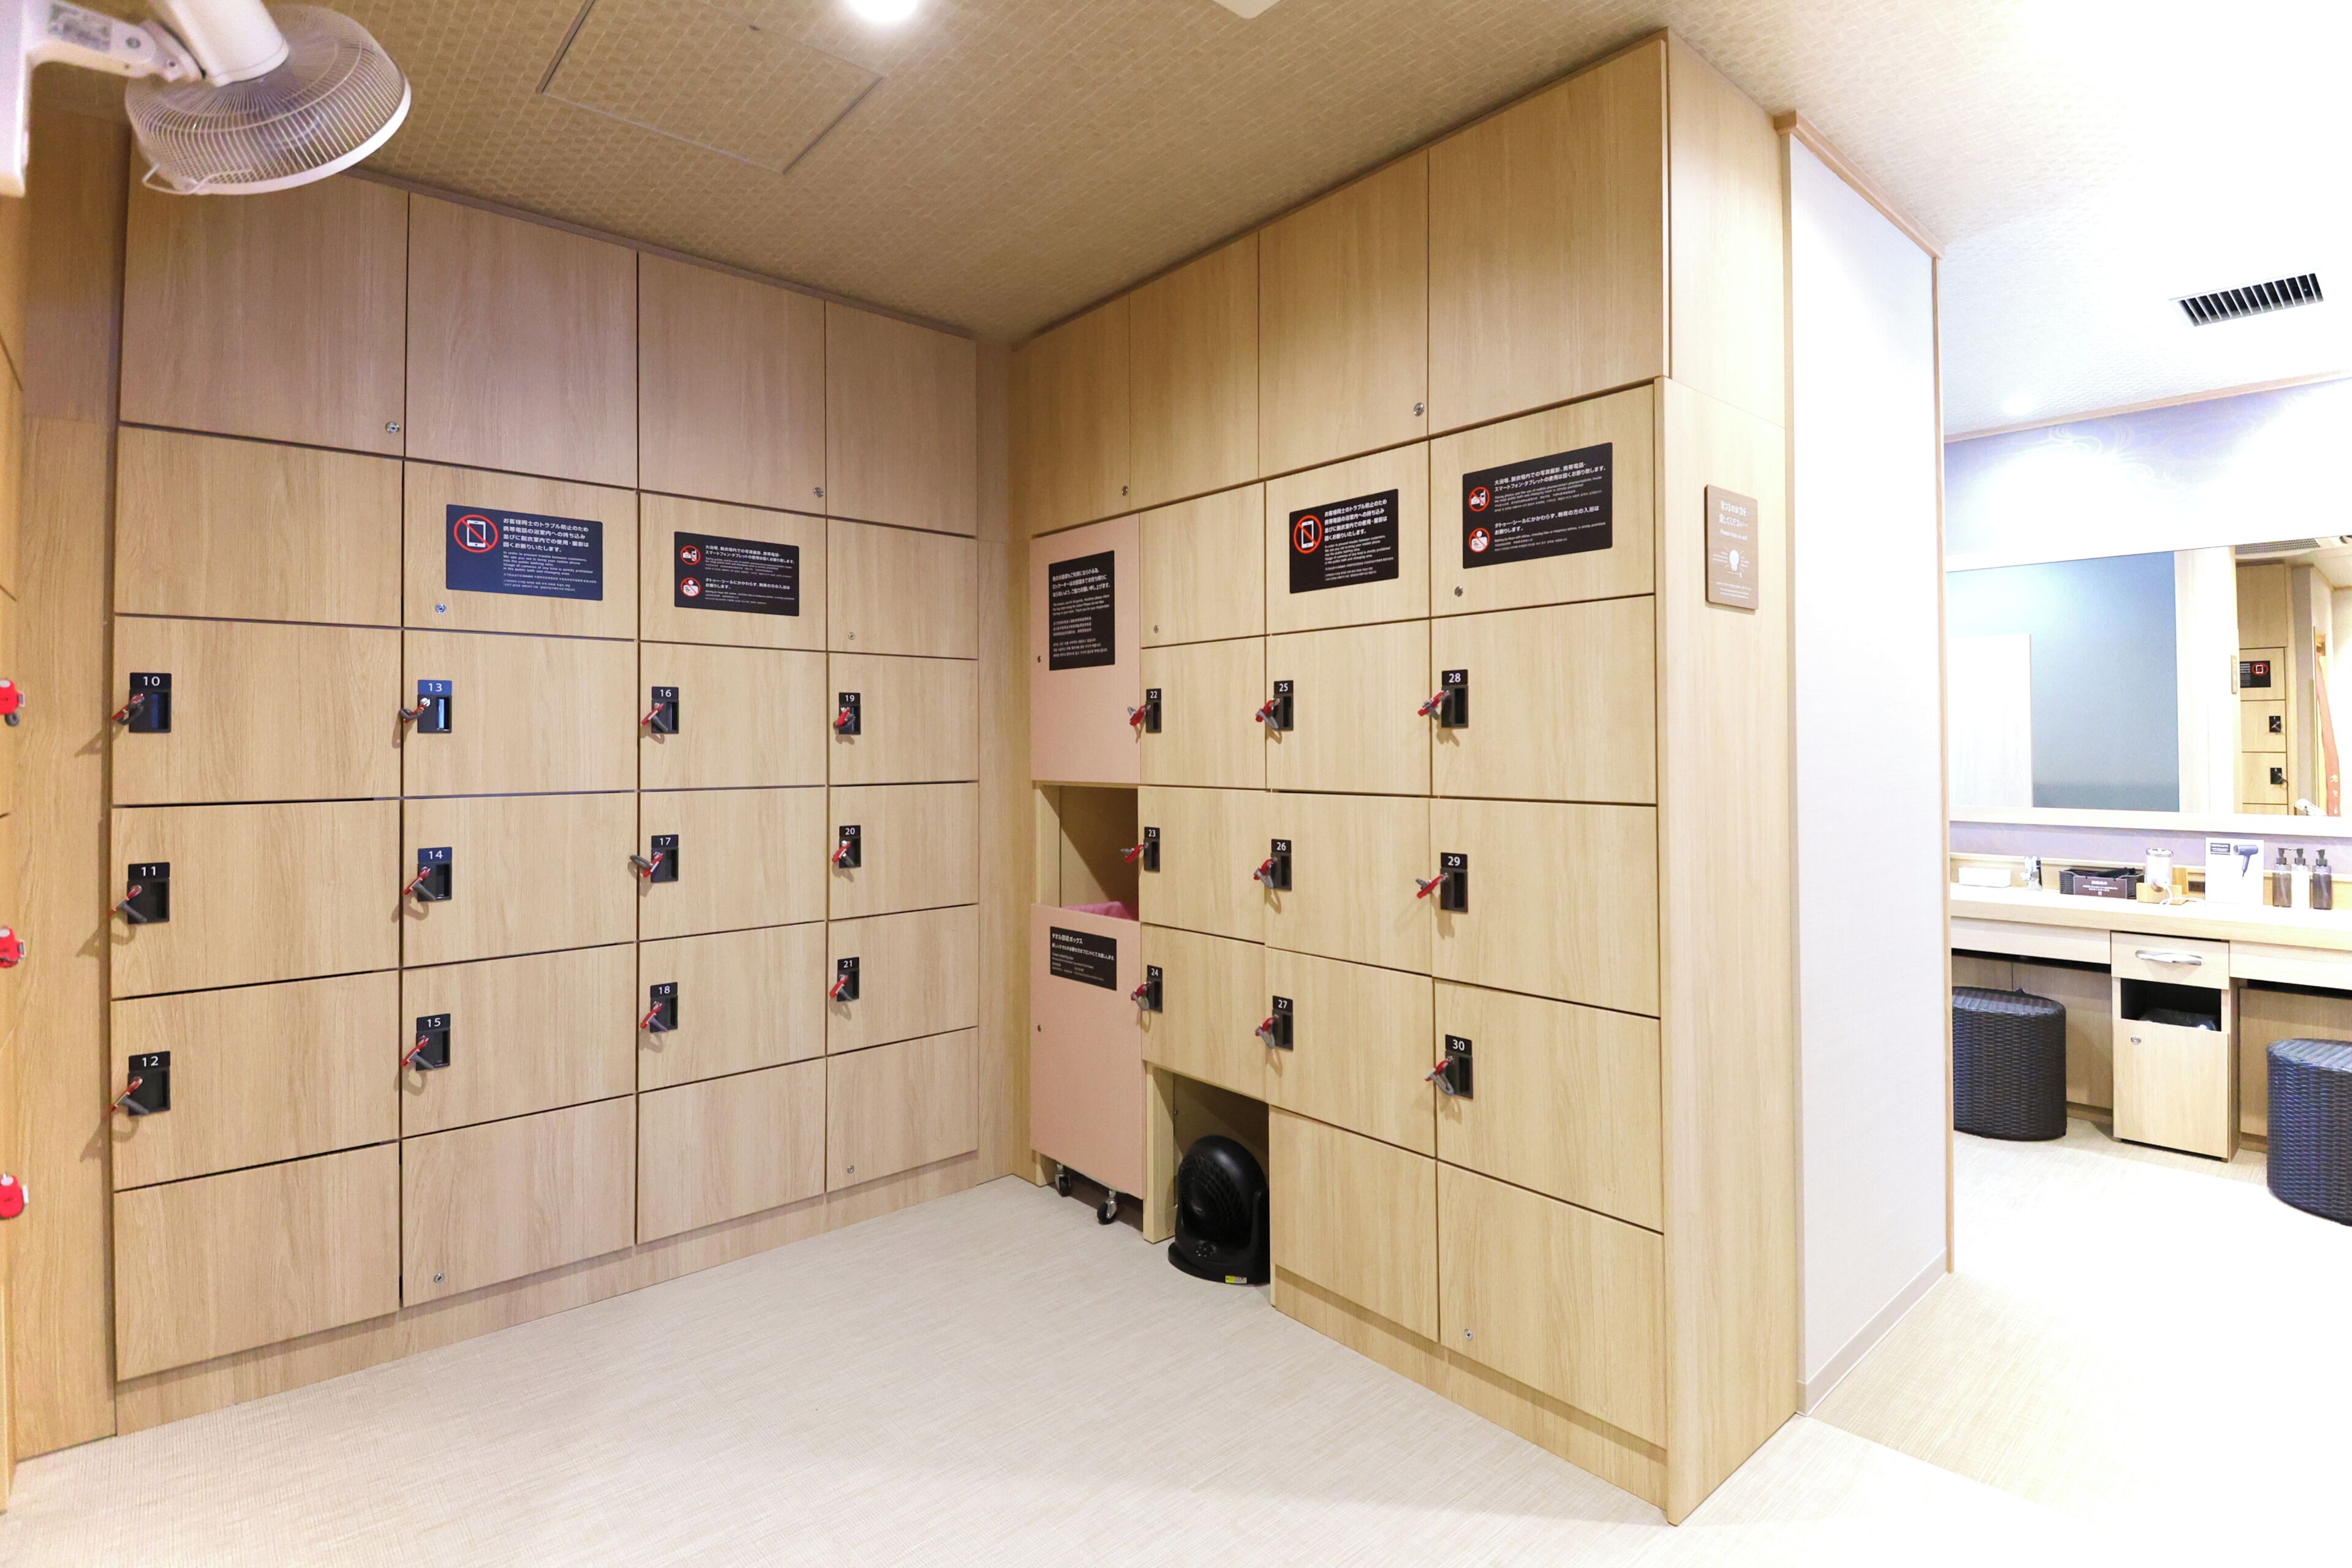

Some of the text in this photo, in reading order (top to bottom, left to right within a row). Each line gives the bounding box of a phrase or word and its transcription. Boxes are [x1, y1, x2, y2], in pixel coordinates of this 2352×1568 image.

[143, 676, 160, 686] 10
[1449, 673, 1461, 683] 28
[428, 683, 442, 692] 13
[1279, 683, 1288, 692] 25
[660, 689, 672, 698] 16
[1276, 842, 1286, 851] 26
[429, 850, 443, 859] 14
[1448, 856, 1460, 866] 29
[141, 866, 156, 876] 11
[843, 960, 853, 968] 21
[1152, 968, 1158, 976] 24
[658, 986, 670, 995] 18
[1278, 999, 1287, 1009] 27
[427, 1017, 441, 1028] 15
[1453, 1039, 1465, 1051] 30
[142, 1056, 159, 1067] 12
